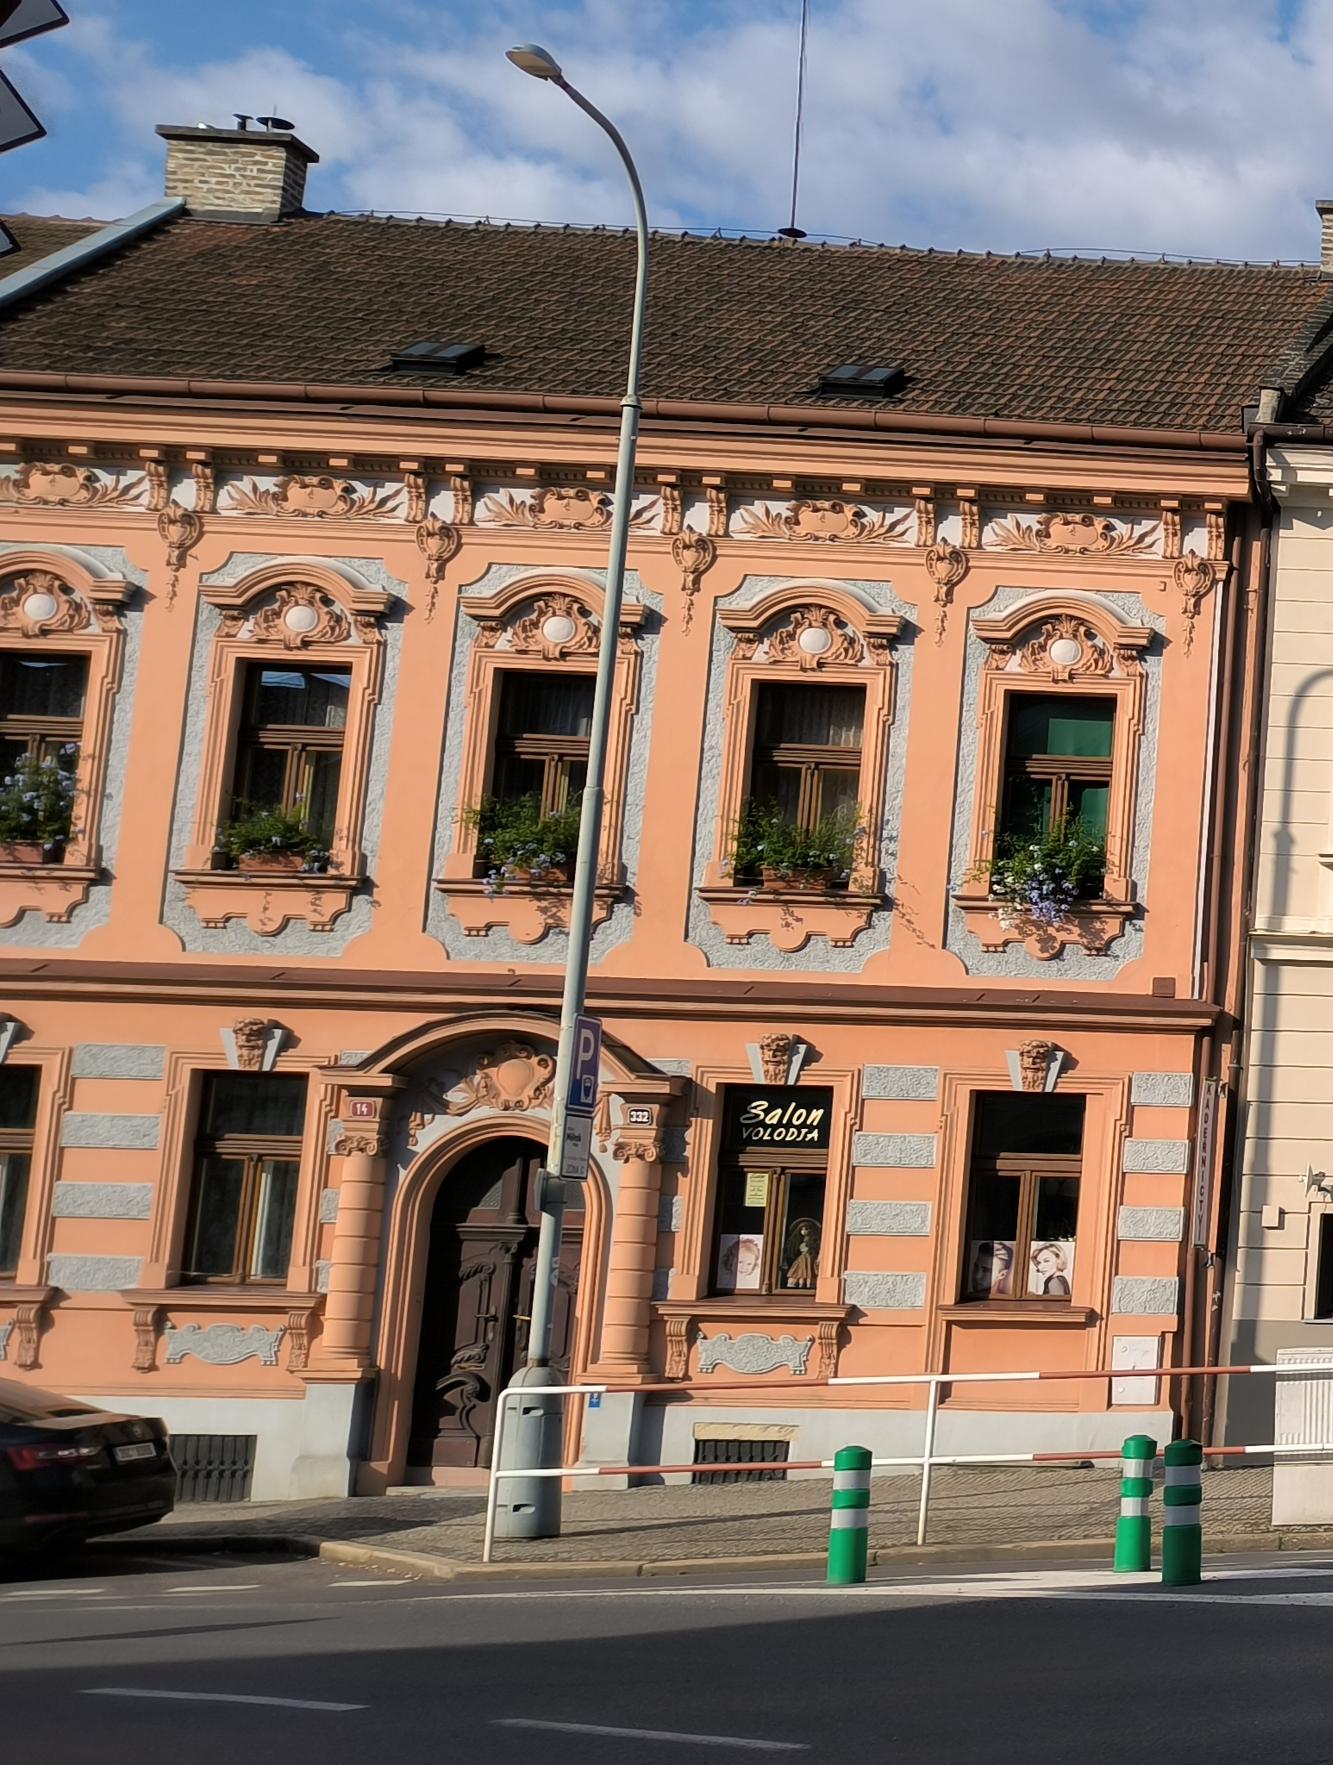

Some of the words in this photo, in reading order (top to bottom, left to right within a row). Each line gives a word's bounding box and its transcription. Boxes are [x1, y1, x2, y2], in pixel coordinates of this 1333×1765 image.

[576, 1028, 595, 1080] P
[356, 1103, 368, 1115] 14
[630, 1111, 649, 1122] 332
[740, 1100, 824, 1126] Salon
[742, 1127, 819, 1142] VOLODJA
